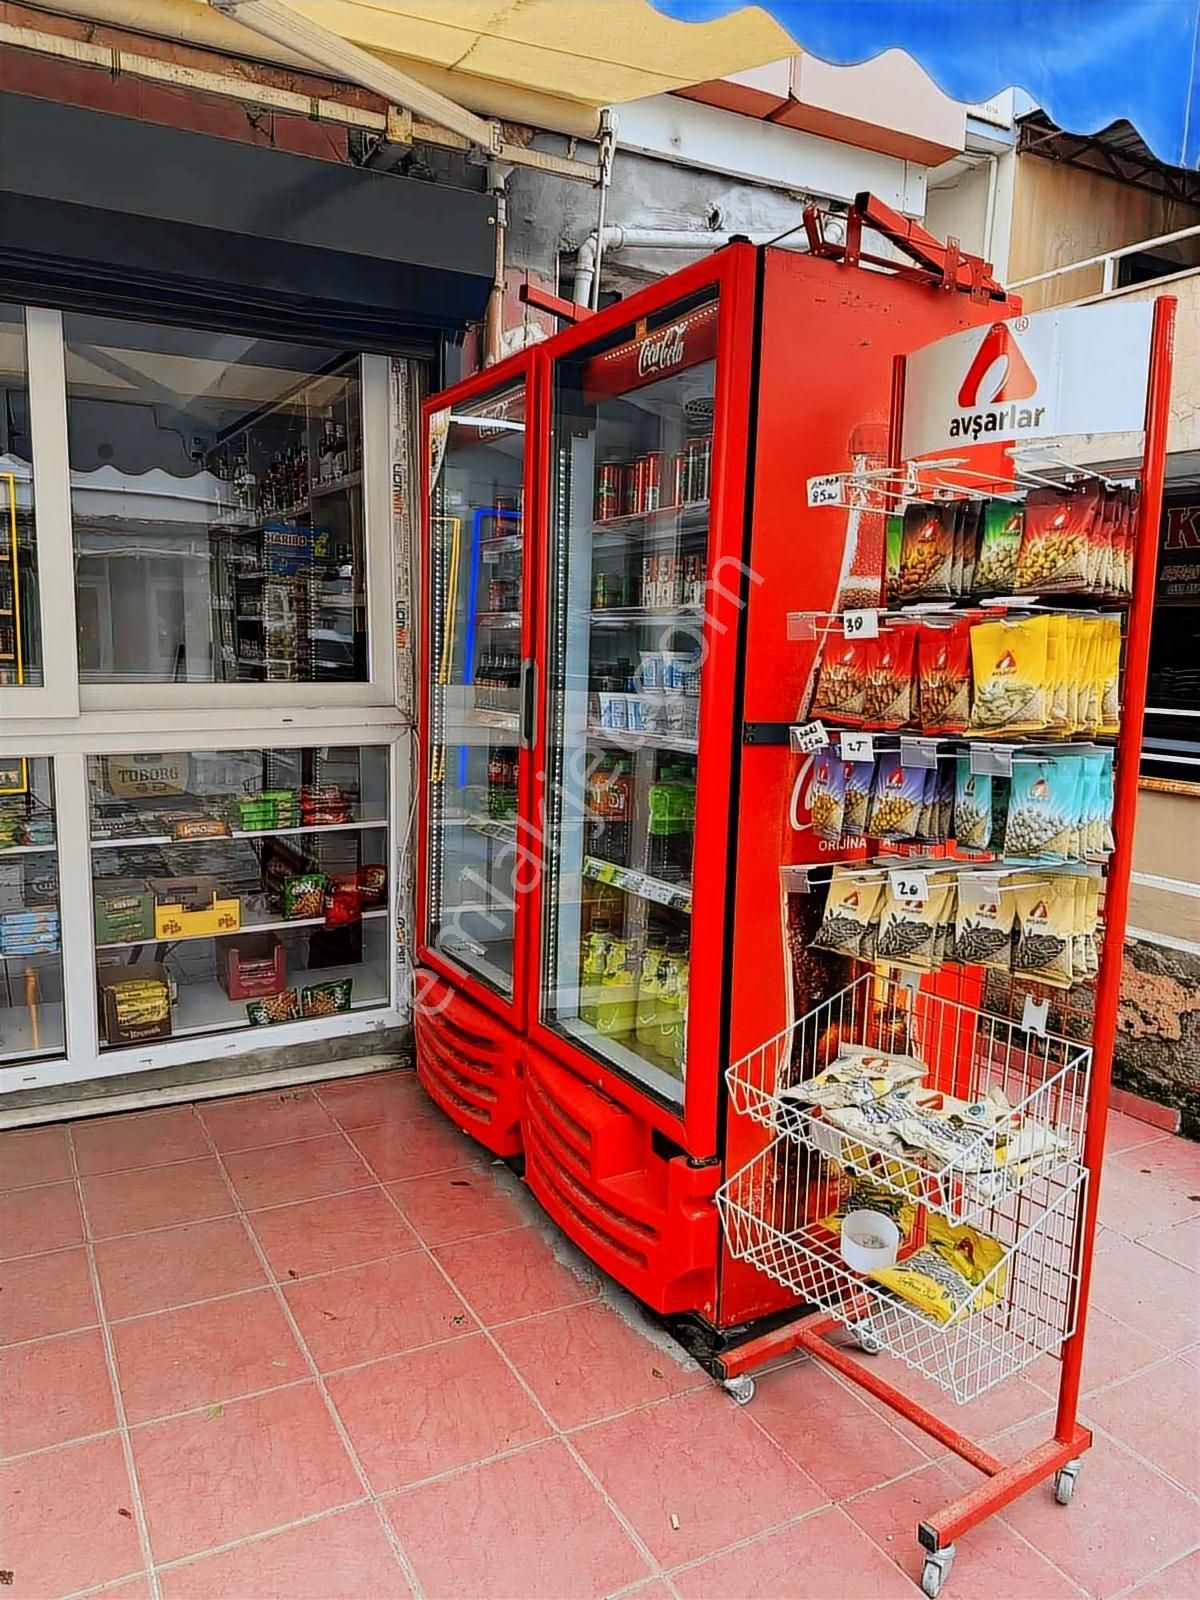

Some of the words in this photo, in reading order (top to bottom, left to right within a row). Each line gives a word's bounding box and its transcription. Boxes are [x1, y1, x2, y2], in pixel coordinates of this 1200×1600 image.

[949, 404, 1045, 441] avşarlar
[846, 616, 863, 633] 30
[118, 766, 178, 784] TUBORG
[898, 881, 919, 896] 20
